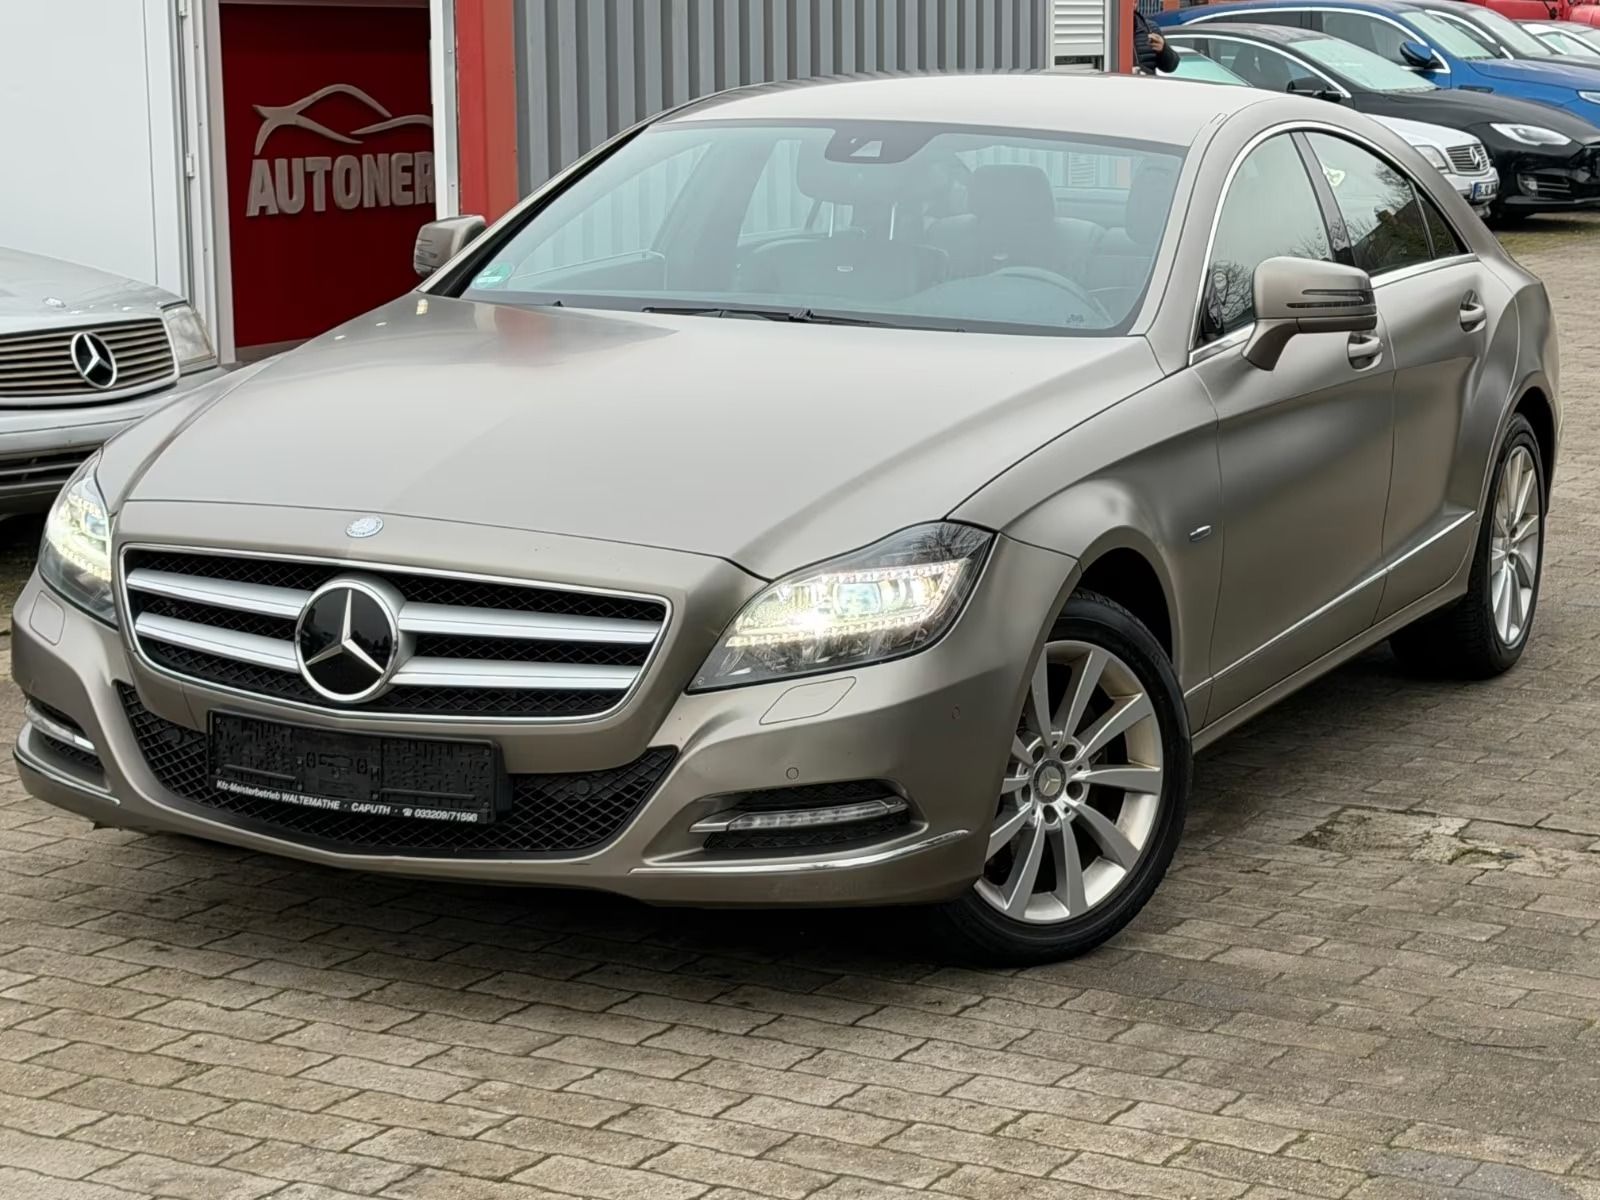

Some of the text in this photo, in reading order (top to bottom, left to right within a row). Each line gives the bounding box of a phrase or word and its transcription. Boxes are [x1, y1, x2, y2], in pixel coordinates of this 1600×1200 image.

[216, 780, 280, 800] Kfz-Meisterbetrieb
[281, 793, 341, 810] WALTEMATHE
[351, 802, 391, 815] CAPUTH
